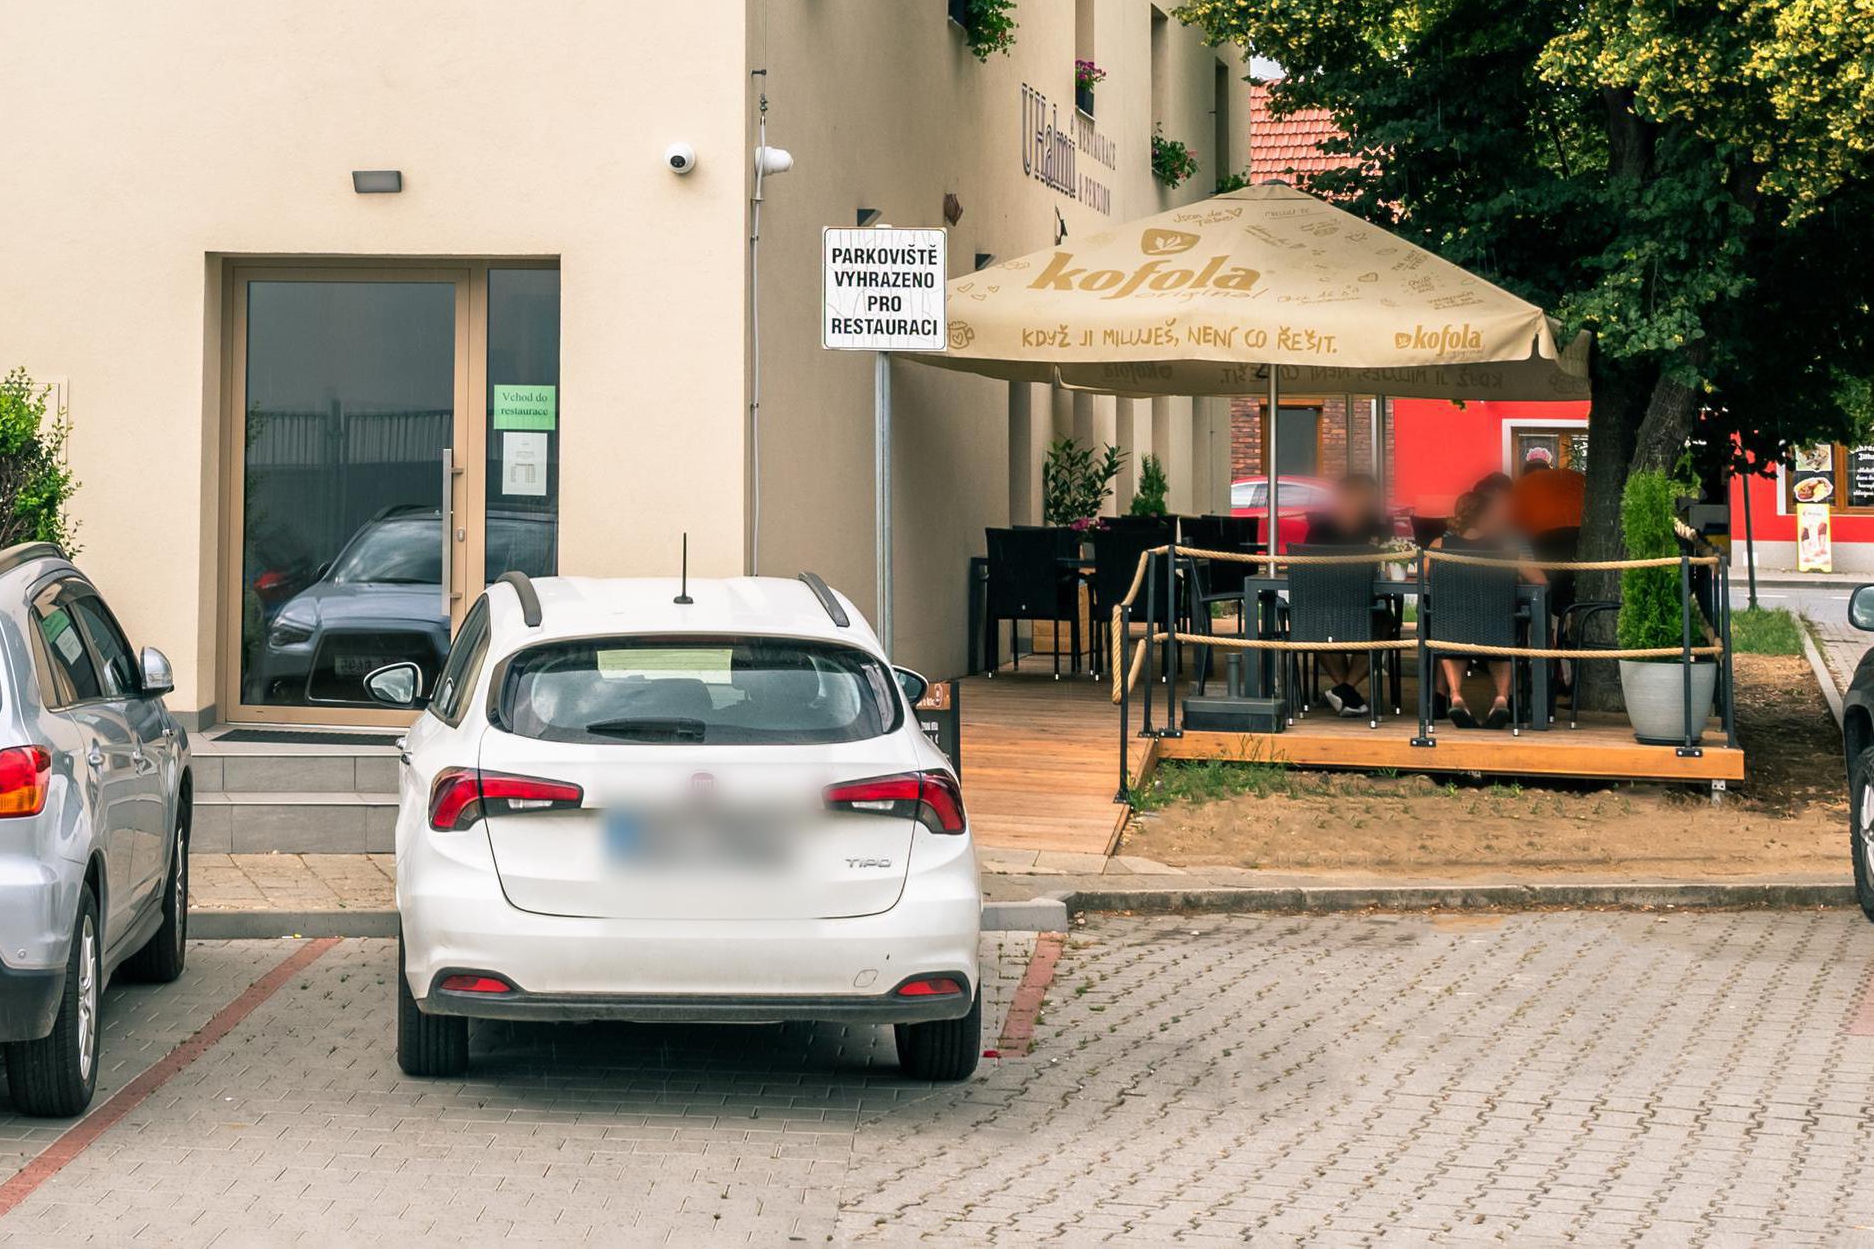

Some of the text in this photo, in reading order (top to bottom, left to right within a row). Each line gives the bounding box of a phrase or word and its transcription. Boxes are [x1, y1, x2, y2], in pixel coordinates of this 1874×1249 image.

[831, 243, 937, 265] PARKOVIŠTĚ
[834, 271, 934, 288] VYHRAZENO
[1027, 252, 1261, 299] kofola
[868, 296, 902, 312] PRO
[831, 318, 937, 335] RESTAURACI
[1022, 318, 1338, 354] KDYŽ JI MILUJEŠ, NENÍ CO ŘEŠIT.
[1413, 323, 1483, 356] kofola
[502, 392, 548, 402] Vchod do
[501, 408, 548, 416] restaurace
[845, 859, 892, 868] TIPO
